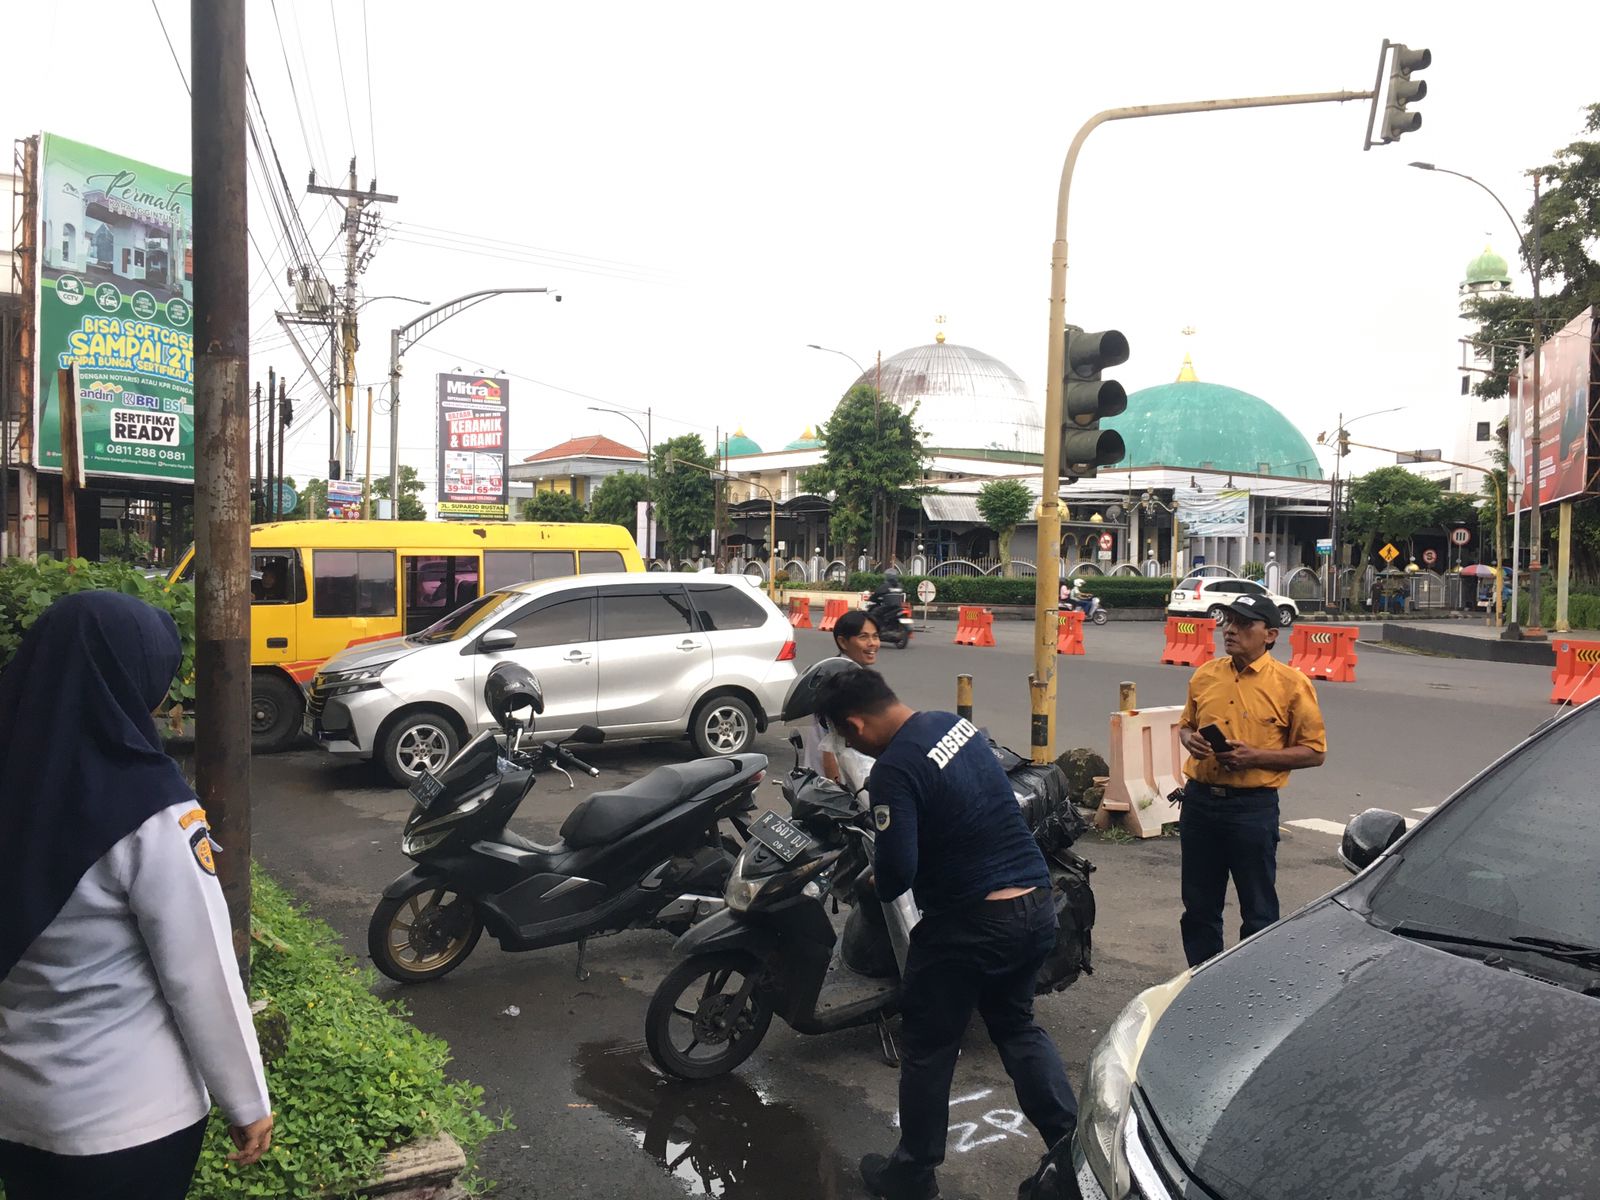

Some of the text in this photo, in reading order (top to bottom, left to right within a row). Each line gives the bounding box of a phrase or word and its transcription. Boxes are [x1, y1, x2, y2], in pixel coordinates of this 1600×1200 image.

[86, 170, 192, 214] Permata
[62, 293, 79, 302] CCTV
[84, 317, 120, 335] BISA
[70, 332, 161, 364] SAMPAI
[98, 355, 133, 368] BUNGA
[141, 378, 158, 387] ATAU
[159, 381, 171, 389] KPR
[80, 388, 113, 401] andiri
[136, 395, 158, 408] BRI
[114, 412, 176, 427] SERTIFIKAT
[450, 418, 501, 434] KERAMIK
[114, 423, 175, 442] READY
[450, 431, 502, 448] & GRANIT
[107, 444, 186, 461] 0811 288 0881
[762, 814, 807, 848] R 2607 DJ
